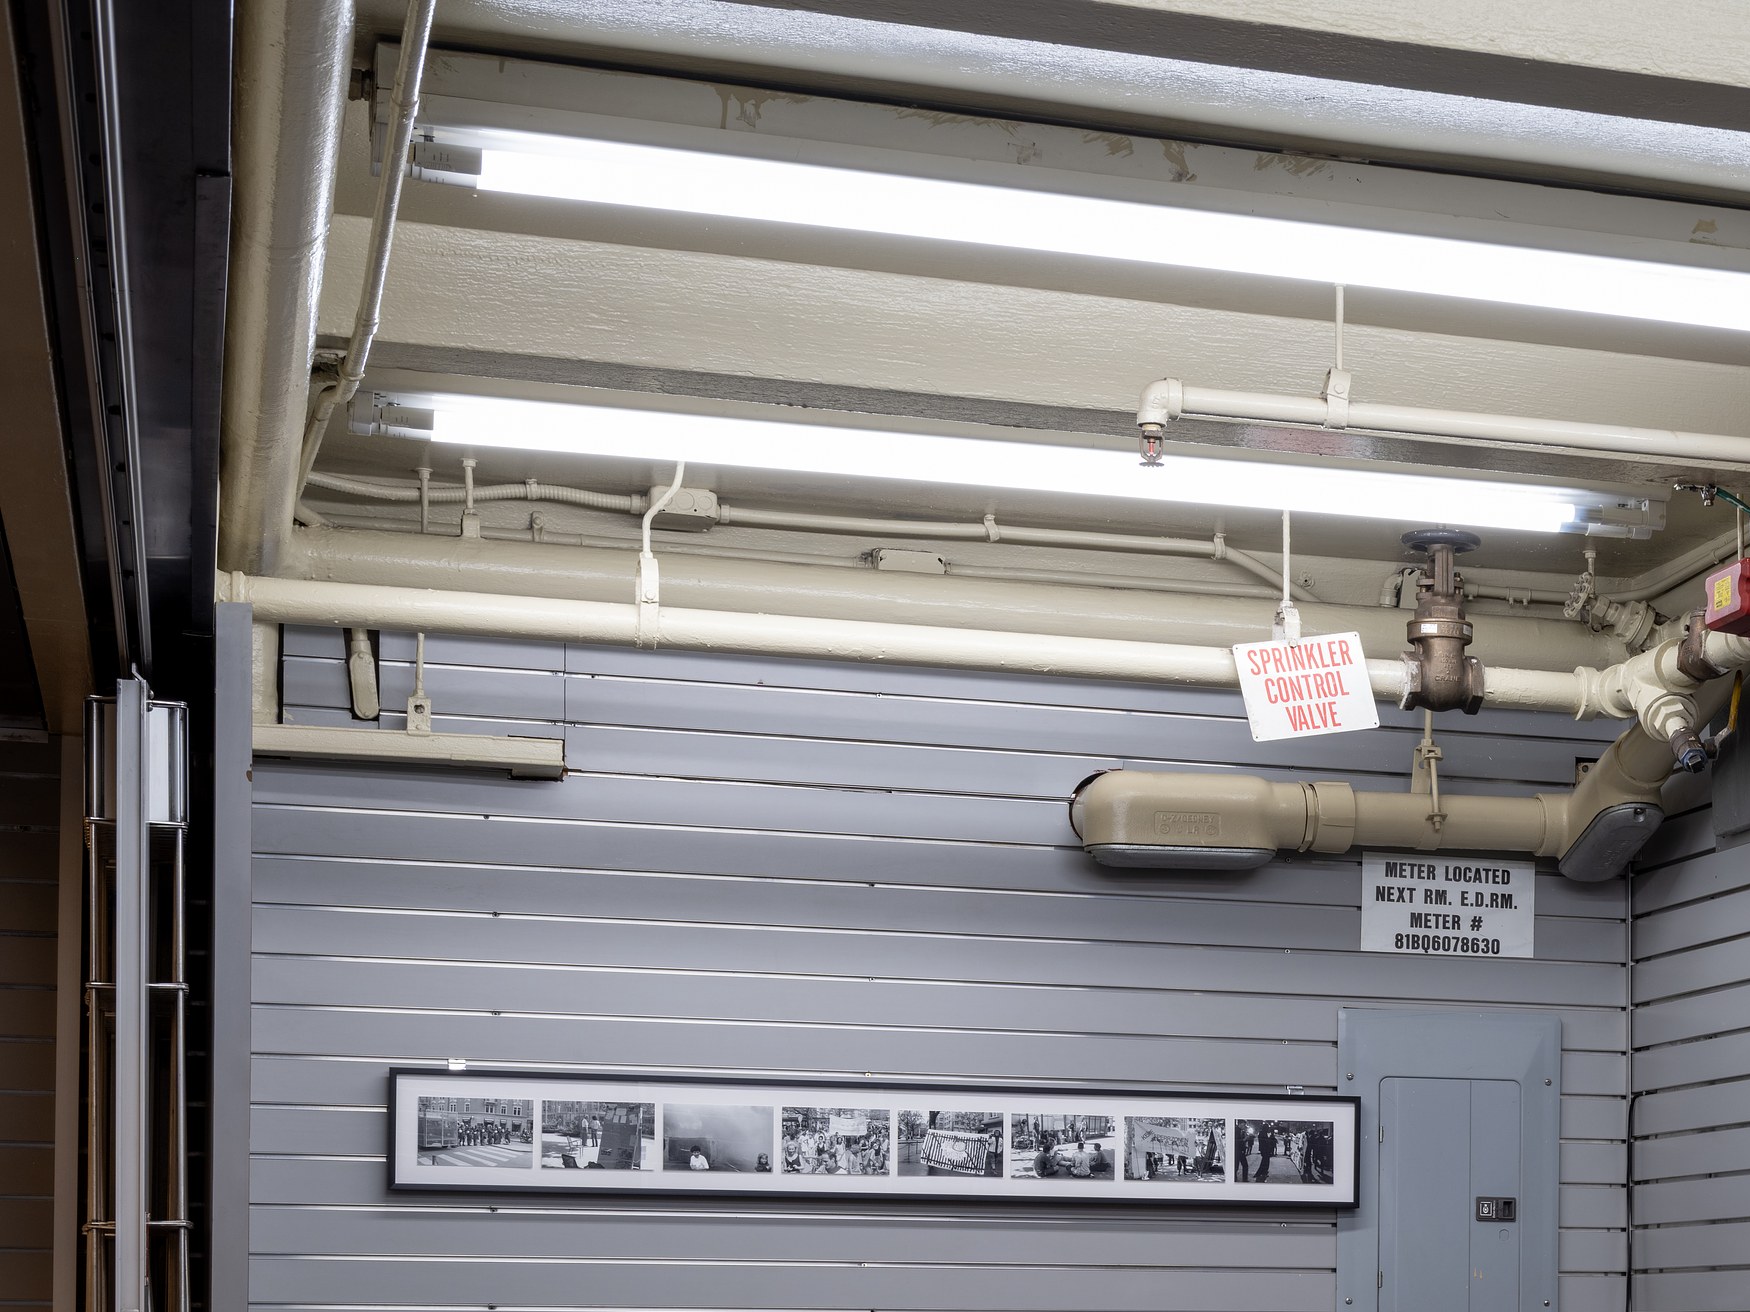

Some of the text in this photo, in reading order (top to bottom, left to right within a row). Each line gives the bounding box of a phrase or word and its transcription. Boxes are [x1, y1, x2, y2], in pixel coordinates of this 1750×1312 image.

[1247, 640, 1353, 676] SPRINKLER
[1264, 670, 1350, 704] CONTROL
[1285, 701, 1342, 732] VALVE
[1385, 861, 1511, 885] METER LOCATED
[1375, 885, 1518, 910] NEXT RM. E.D.RM.
[1410, 912, 1483, 932] METER #
[1395, 932, 1500, 954] 81BQ6078630
